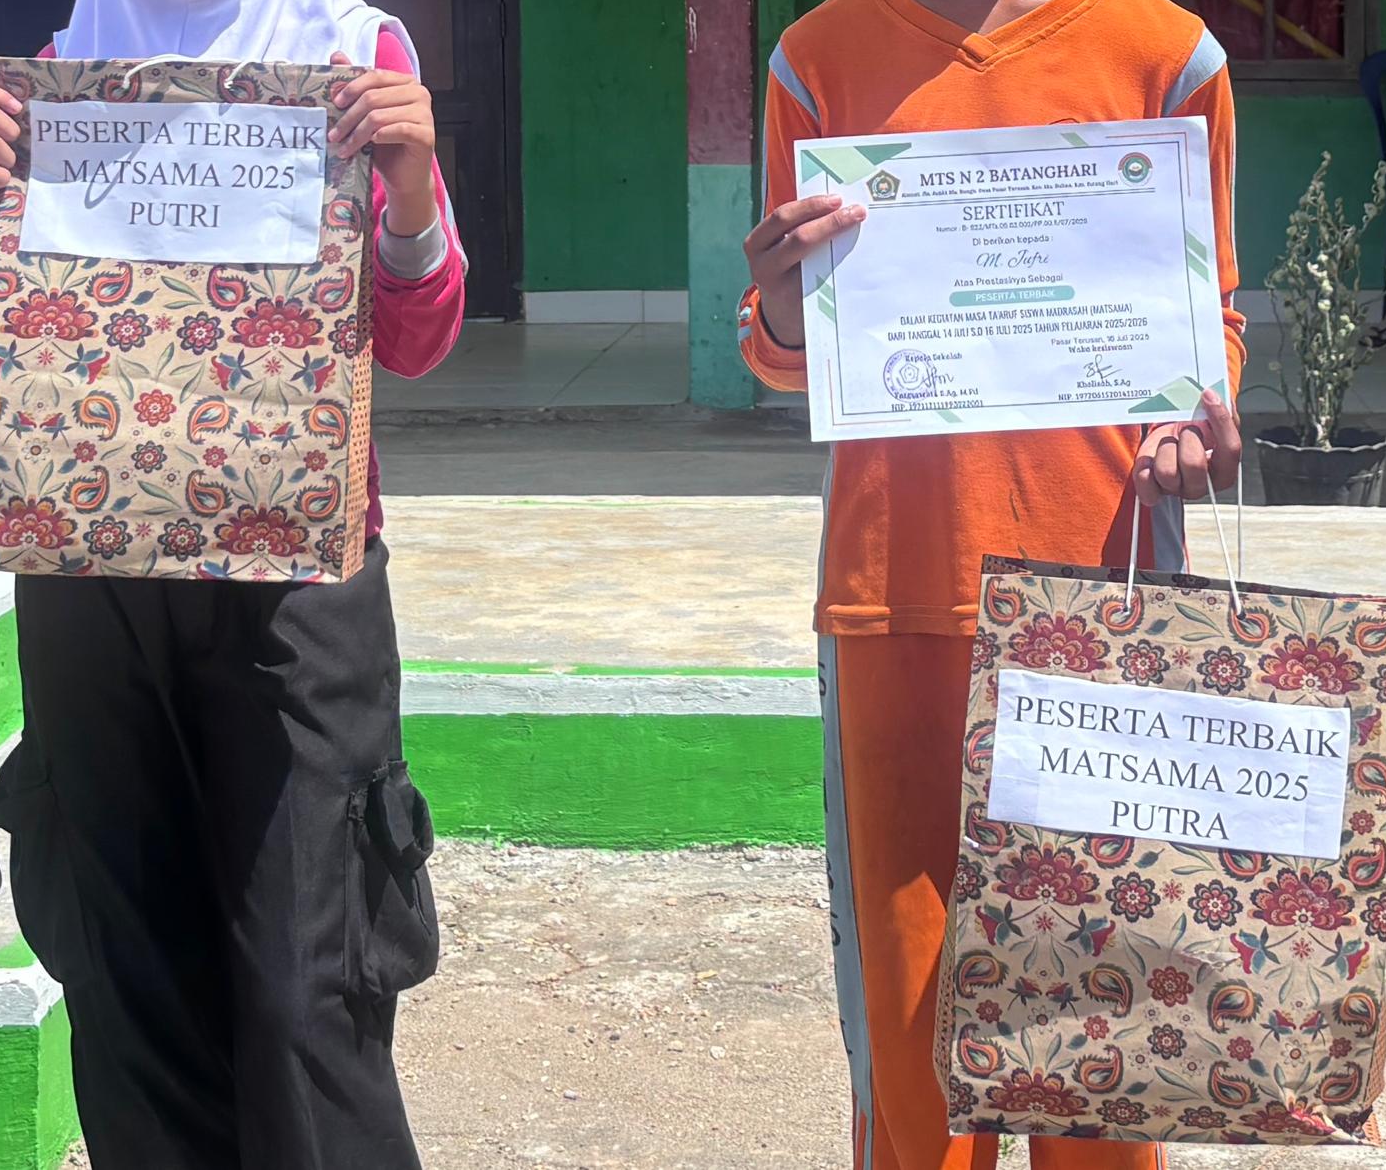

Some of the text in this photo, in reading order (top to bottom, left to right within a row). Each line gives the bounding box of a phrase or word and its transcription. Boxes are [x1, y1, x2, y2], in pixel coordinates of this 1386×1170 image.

[37, 119, 323, 151] PESERTA TERBAIK
[62, 159, 295, 190] MATSAMA 2025
[919, 163, 1098, 187] MTS N 2 BATANGHARI
[129, 201, 222, 229] PUTRI
[963, 201, 1065, 221] SERTIFIKAT
[983, 236, 1015, 246] berikan
[1017, 234, 1049, 246] kepada
[976, 249, 1049, 268] M. Jufri
[954, 279, 974, 287] Atas
[1028, 273, 1063, 285] Sebagai
[975, 290, 1055, 302] PESERTA TERBAIK
[900, 315, 926, 325] DALAM
[928, 313, 964, 324] KEGIATAN
[965, 311, 987, 321] MASA
[1020, 308, 1044, 319] SISWA
[1046, 306, 1088, 317] MADRASAH
[1090, 303, 1133, 316] (MATSAMA)
[888, 332, 906, 341] DARI
[908, 330, 941, 340] TANGGAL
[943, 329, 952, 338] 14
[985, 326, 994, 336] 16
[996, 324, 1011, 335] JULI
[1013, 323, 1033, 334] 2025
[1035, 322, 1059, 333] TAHUN
[1061, 320, 1103, 332] PELAJARAN
[1105, 317, 1148, 329] 2025/2026
[1013, 695, 1342, 759] PESERTA TERBAIK
[1037, 744, 1309, 802] MATSAMA 2025
[1109, 800, 1230, 841] PUTRA
